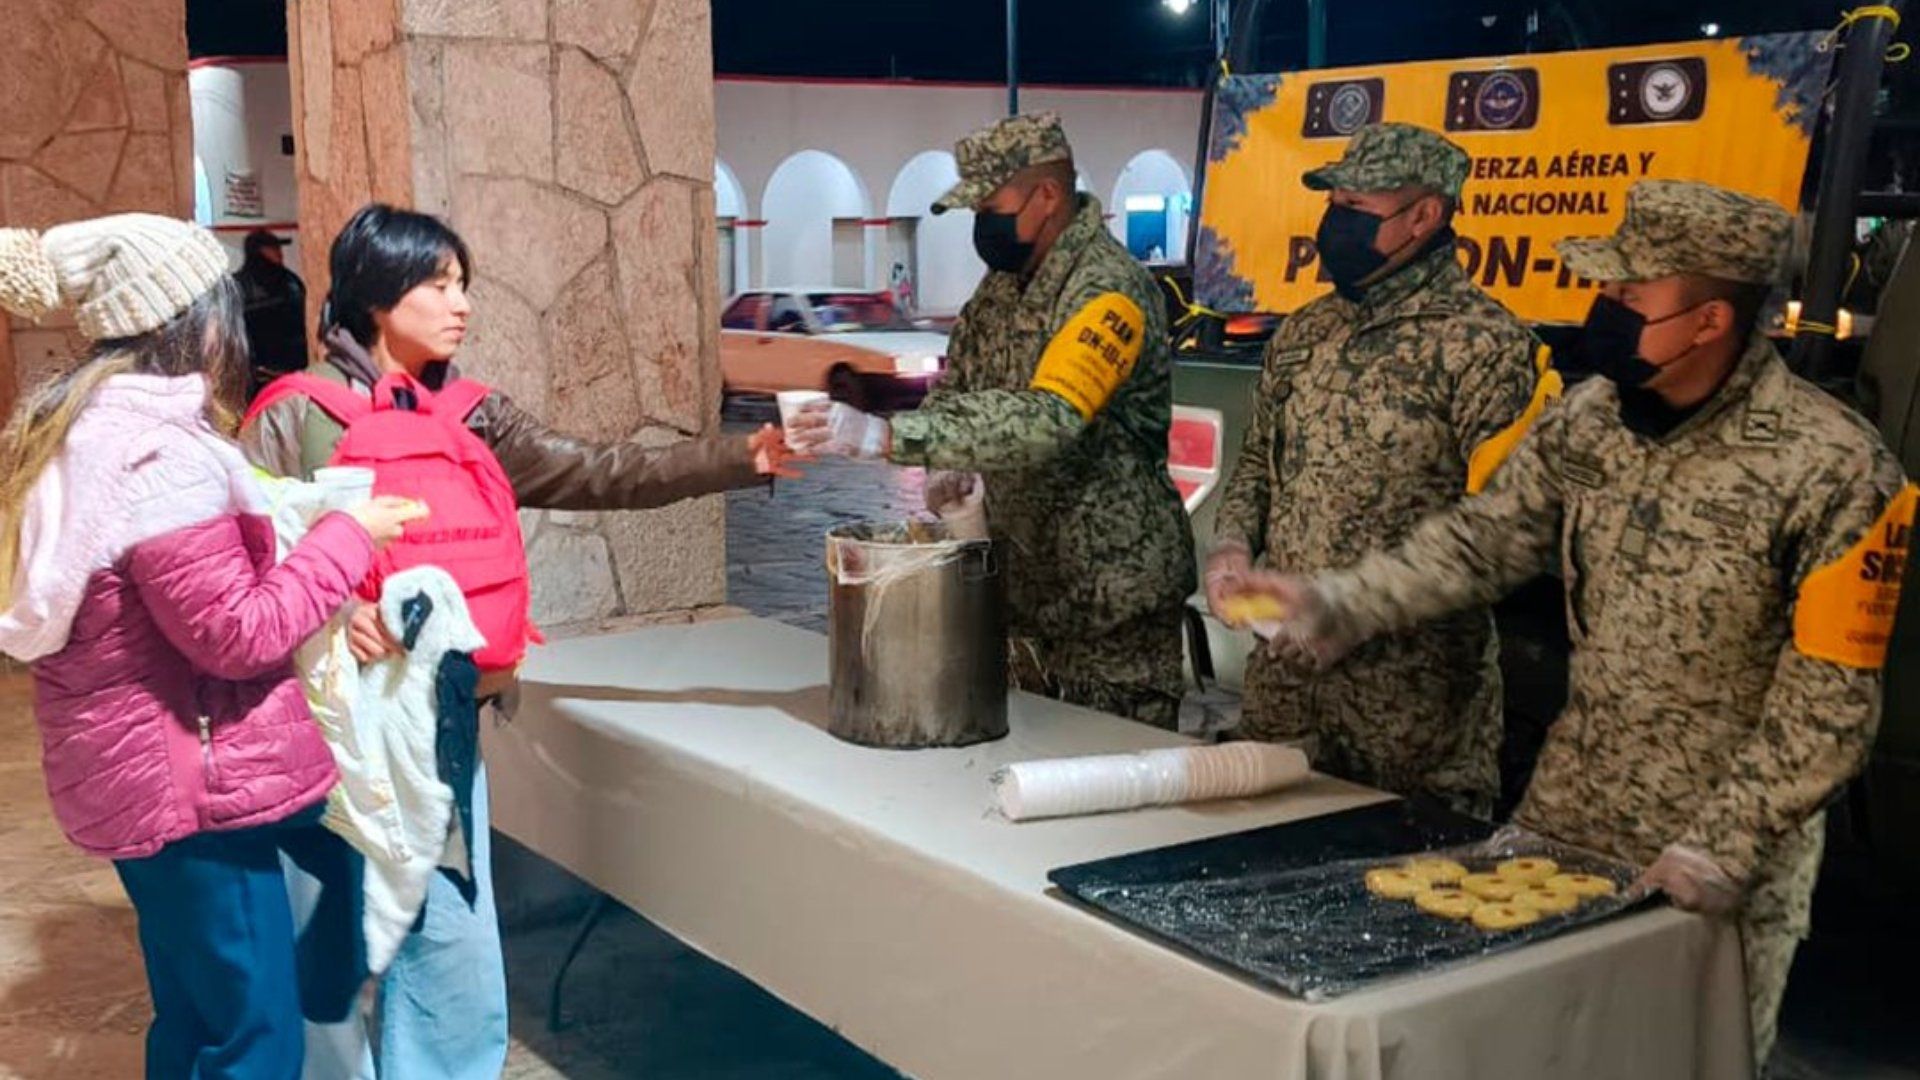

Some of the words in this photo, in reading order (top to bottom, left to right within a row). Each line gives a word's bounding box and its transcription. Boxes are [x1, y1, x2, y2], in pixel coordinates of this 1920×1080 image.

[1469, 156, 1539, 179] ERZA
[1545, 150, 1630, 178] AÉREA
[1638, 152, 1655, 175] Y
[1472, 191, 1609, 215] NACIONAL
